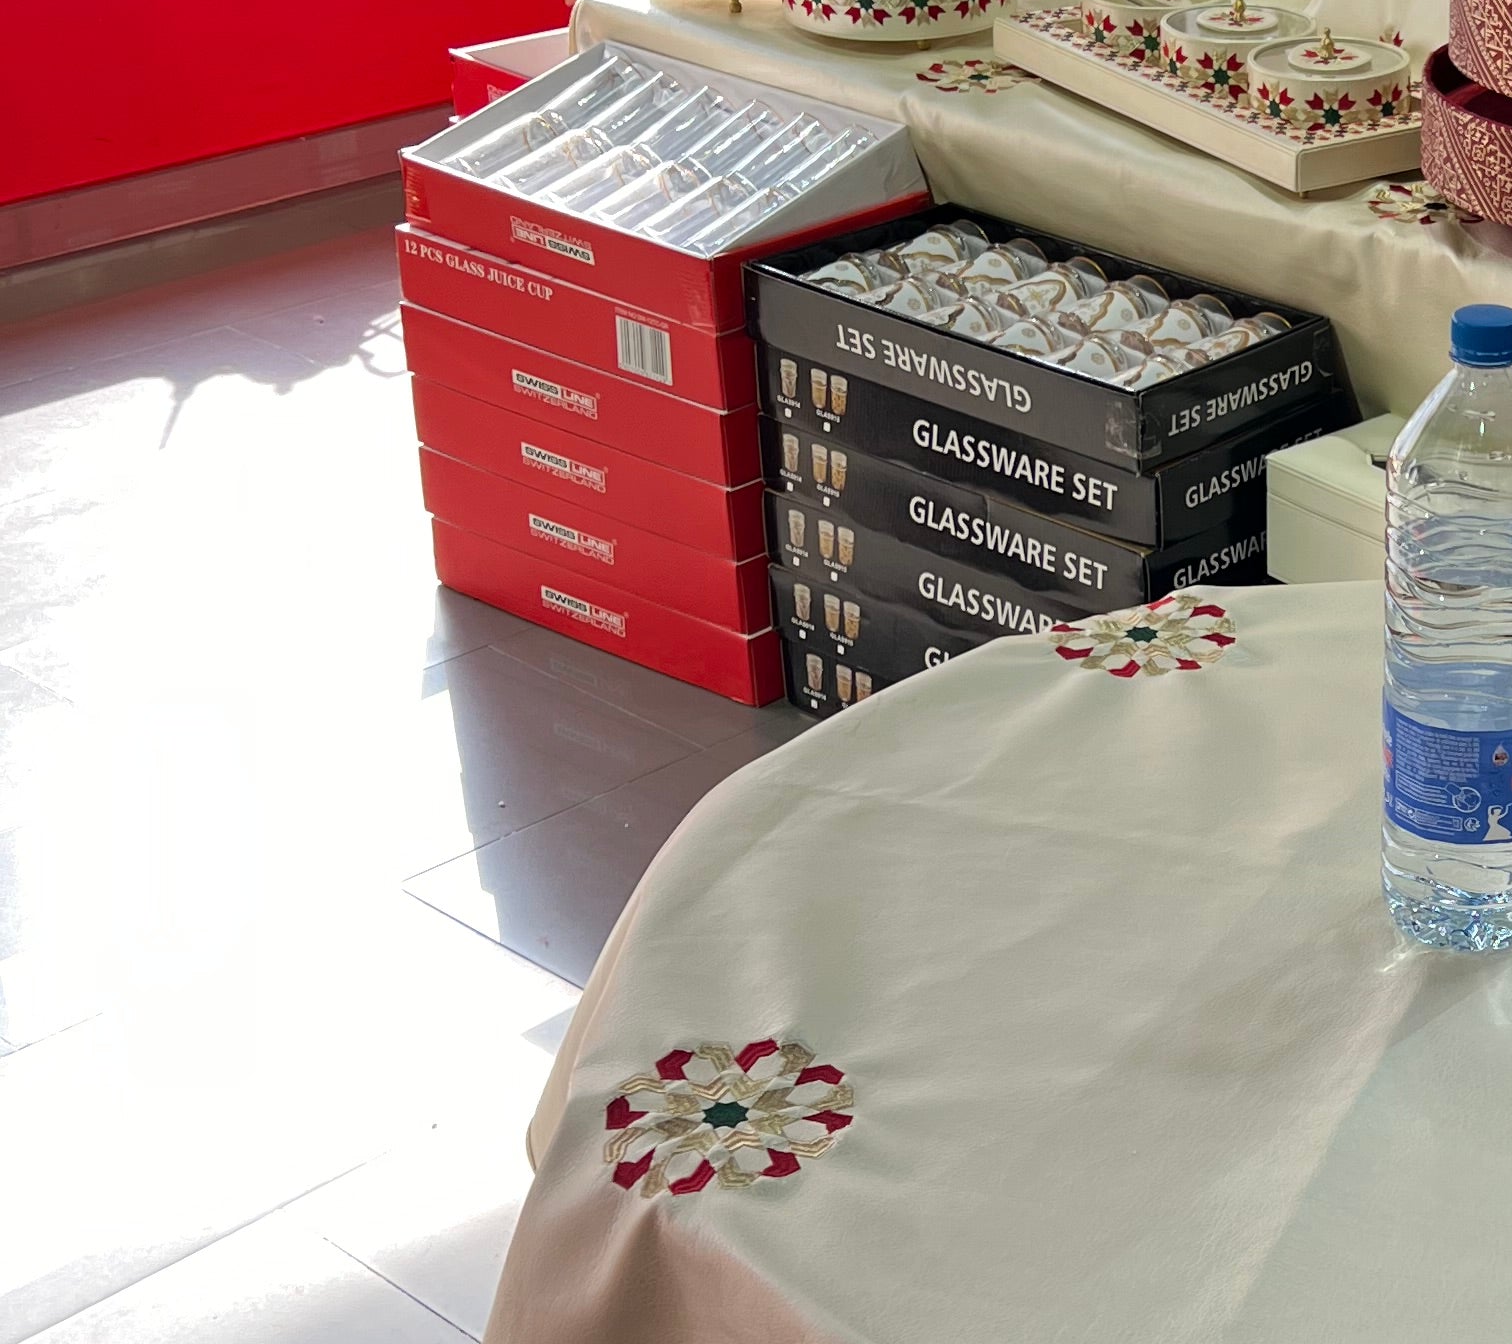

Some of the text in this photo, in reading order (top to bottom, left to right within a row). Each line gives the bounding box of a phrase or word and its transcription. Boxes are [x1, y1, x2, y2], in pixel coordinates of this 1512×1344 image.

[404, 239, 553, 301] 12 PCS GLASS JUICE CUP
[835, 323, 1032, 413] GLASSWARE SET
[514, 385, 598, 420] SWITZERLAND
[516, 372, 595, 409] SWISS LINE
[1168, 360, 1314, 437] GLASSWARE SET
[522, 457, 606, 494] SWITZERLAND
[525, 446, 602, 482] SWISS LINE
[912, 419, 1118, 511] GLASSWARE SET
[1185, 453, 1267, 509] GLASSWA
[530, 528, 615, 566] SWITZERLAND
[532, 517, 610, 554] SWISS LINE
[909, 495, 1108, 590] GLASSWARE SET
[542, 600, 626, 638] SWITZERLAND
[544, 589, 622, 626] SWISS LINE
[918, 571, 1064, 634] GLASSWAR
